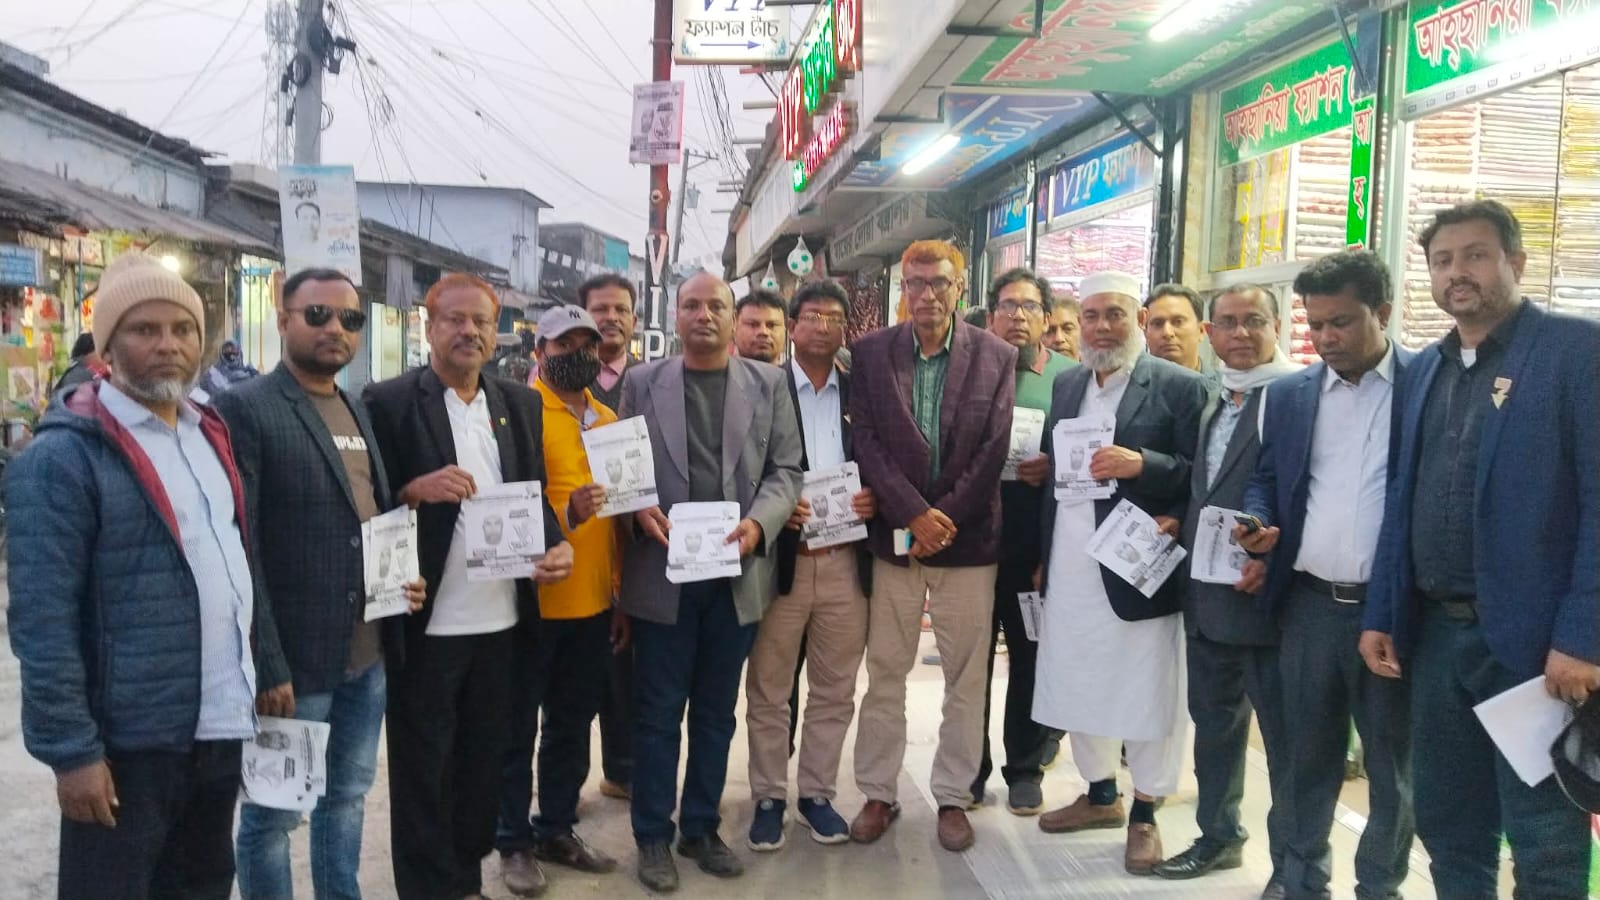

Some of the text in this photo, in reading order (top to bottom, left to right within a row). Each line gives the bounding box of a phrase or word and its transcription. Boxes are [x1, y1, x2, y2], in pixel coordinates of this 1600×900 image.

[684, 19, 745, 37] ফ্যাশন
[1292, 64, 1347, 126] ফ্যাশন
[1056, 158, 1100, 209] VIP
[994, 197, 1012, 230] VIP
